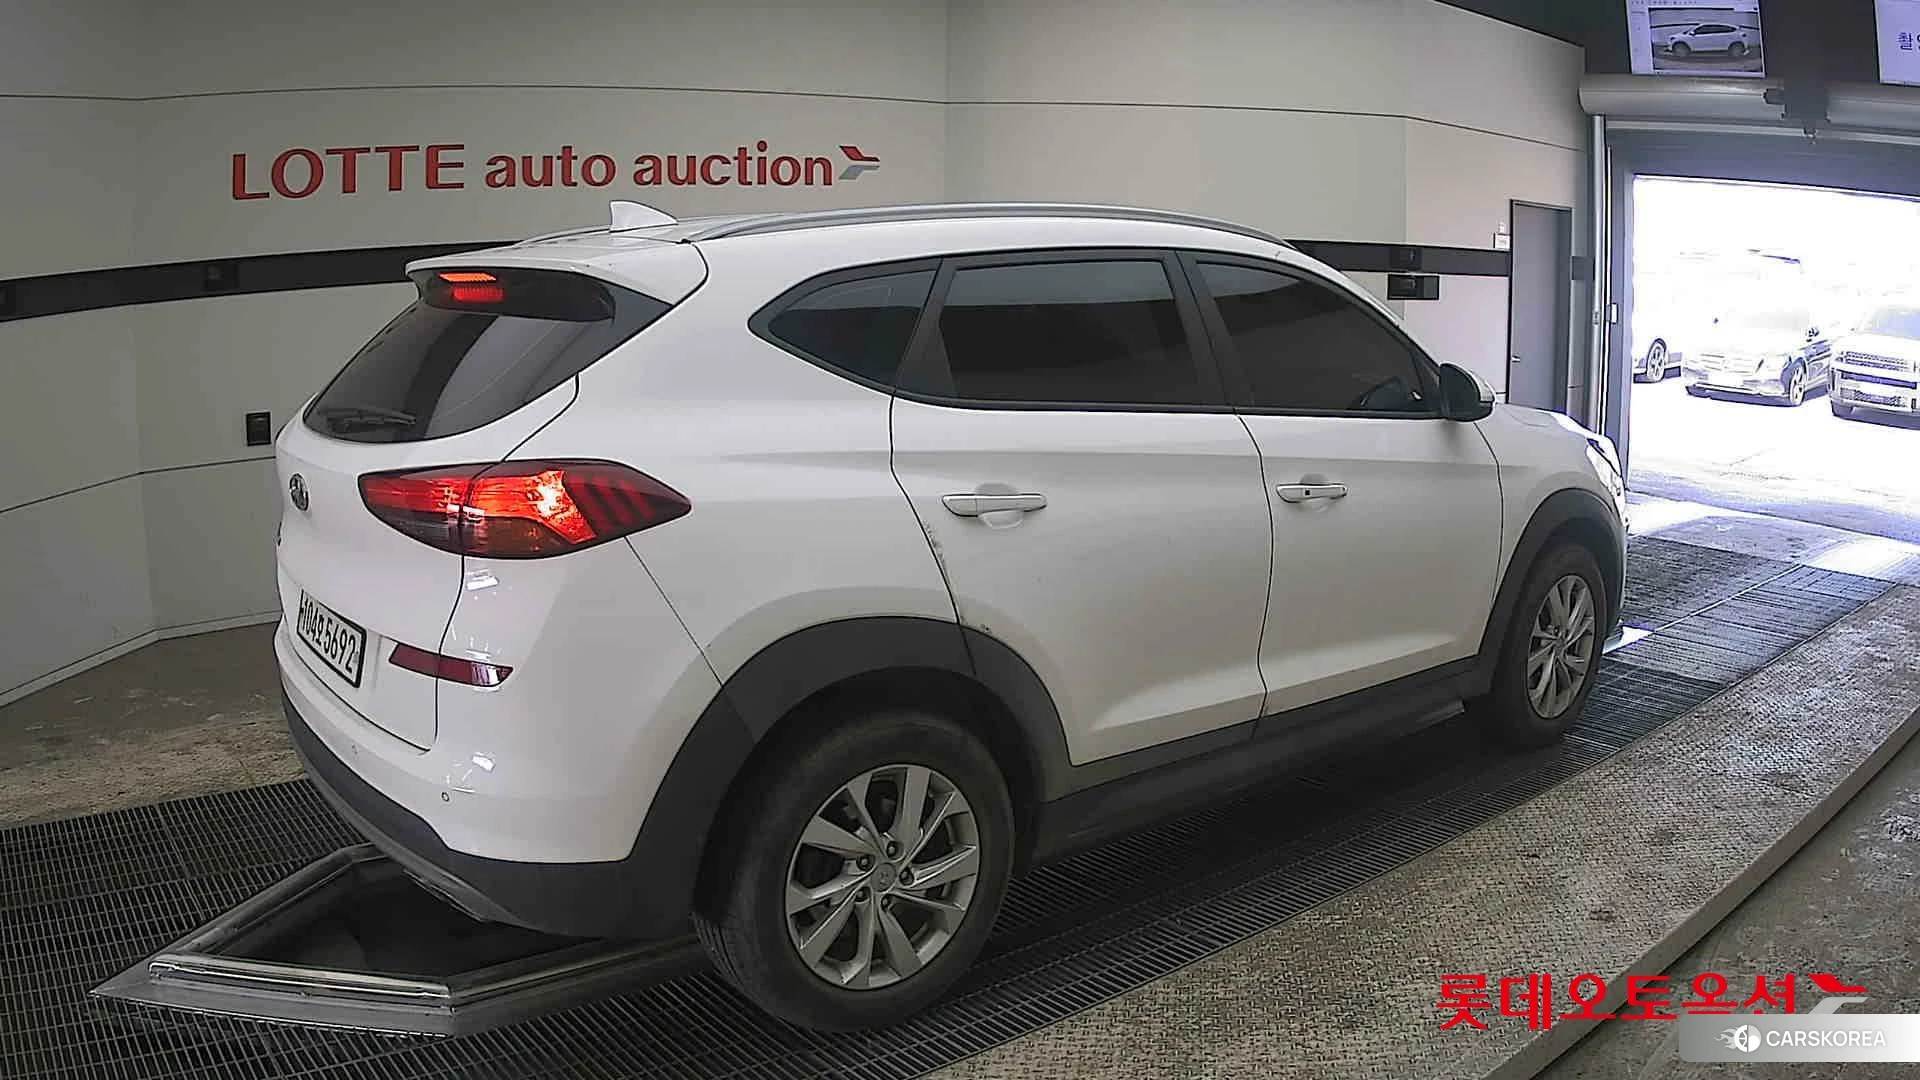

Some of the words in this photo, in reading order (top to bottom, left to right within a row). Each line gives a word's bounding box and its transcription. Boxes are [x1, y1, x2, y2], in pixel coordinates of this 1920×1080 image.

[231, 144, 465, 200] LOTTE
[485, 145, 617, 188] auto
[633, 141, 833, 187] auction
